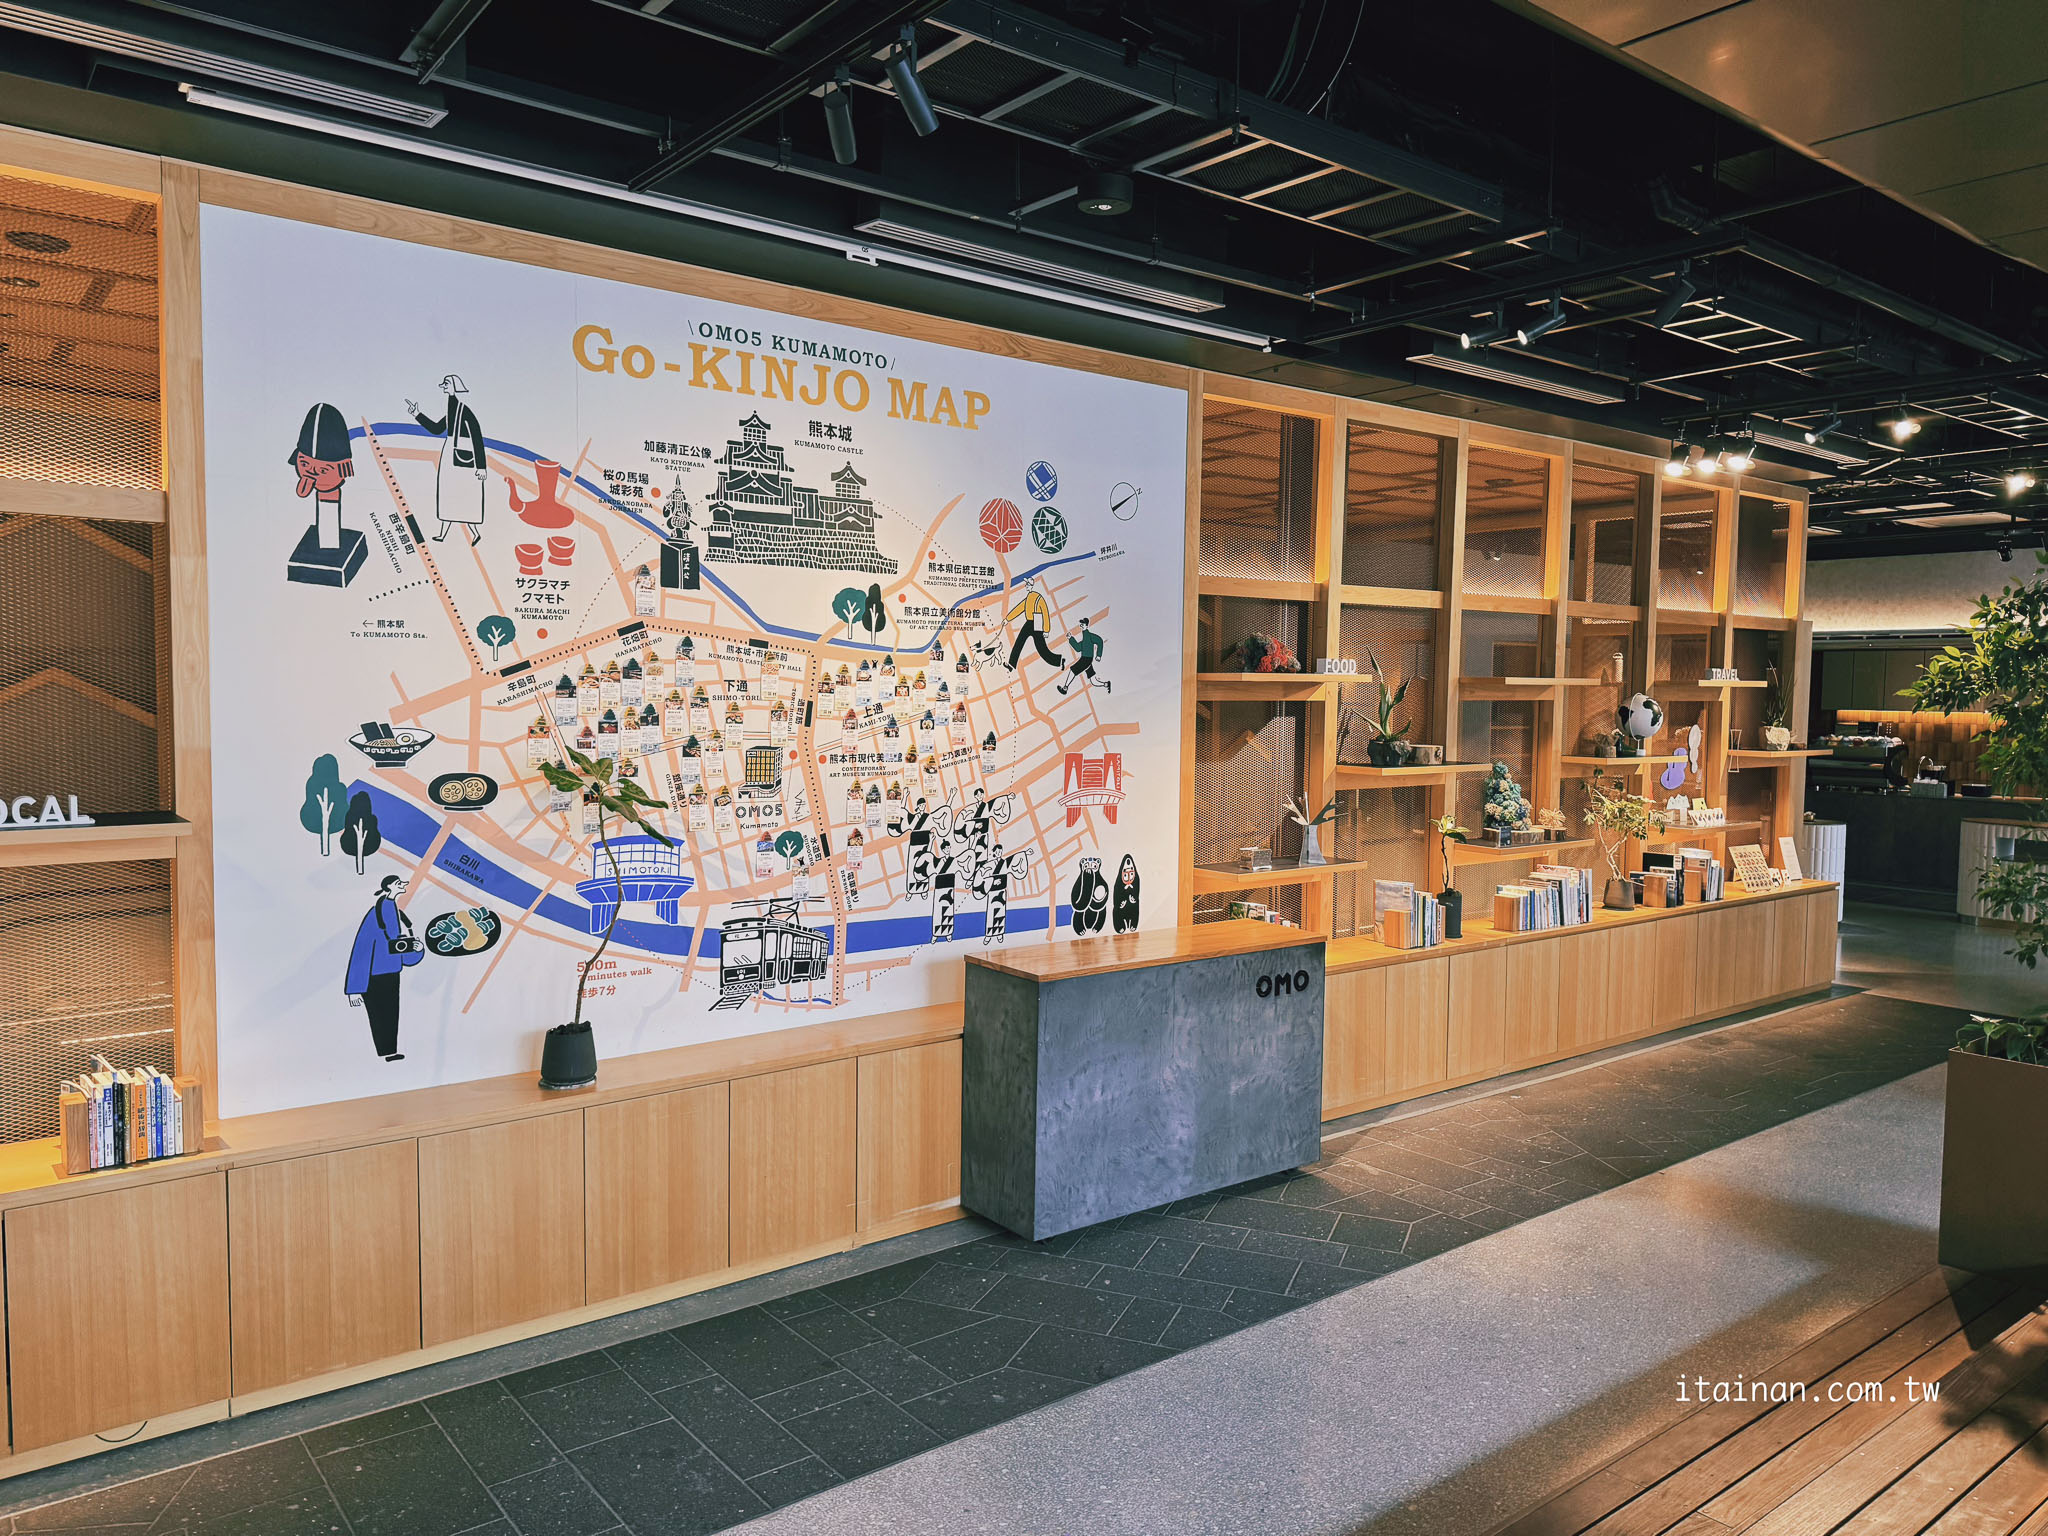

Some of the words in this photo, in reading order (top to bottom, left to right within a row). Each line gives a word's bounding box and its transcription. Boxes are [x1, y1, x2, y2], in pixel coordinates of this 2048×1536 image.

[698, 322, 762, 347] OMO5
[772, 334, 887, 369] KUMAMOTO
[887, 377, 991, 430] MAP
[808, 419, 853, 442] 熊本城
[644, 440, 712, 459] 加藤清正公像
[794, 440, 835, 451] KUMAMOTO
[837, 445, 864, 455] CASTLE
[650, 456, 669, 464] KATO
[671, 459, 705, 469] KIYOMASA
[603, 468, 649, 485] 桜の馬場
[609, 483, 644, 498] 城彩苑
[385, 529, 400, 552] NISHI
[388, 511, 416, 555] 西辛島町
[369, 511, 402, 574] KARASHIMACHO
[928, 562, 995, 577] 熊本県伝統工芸館
[514, 577, 571, 590] サクラマチ
[521, 592, 565, 605] クマモト
[514, 606, 545, 614] SAKURA
[546, 607, 570, 615] MACHI
[521, 613, 563, 621] KUMAMOTO
[377, 619, 405, 629] 熊本駅
[363, 631, 411, 639] KUMAMOTO
[620, 630, 649, 647] 花畑町
[708, 652, 744, 663] KUMAMOTO
[1326, 658, 1357, 673] FOOD
[1711, 667, 1739, 680] TRAVEL
[506, 674, 537, 692] 辛島町
[723, 679, 748, 693] 下通
[496, 679, 554, 706] KARASHIMACHO
[863, 702, 884, 719] 上通
[735, 803, 783, 819] OMO5
[810, 836, 823, 862] 水道町
[459, 854, 480, 871] 白川
[443, 859, 484, 884] SHIRAKAWA
[587, 970, 627, 981] minutes
[630, 966, 652, 977] walk
[1256, 969, 1310, 998] OMO
